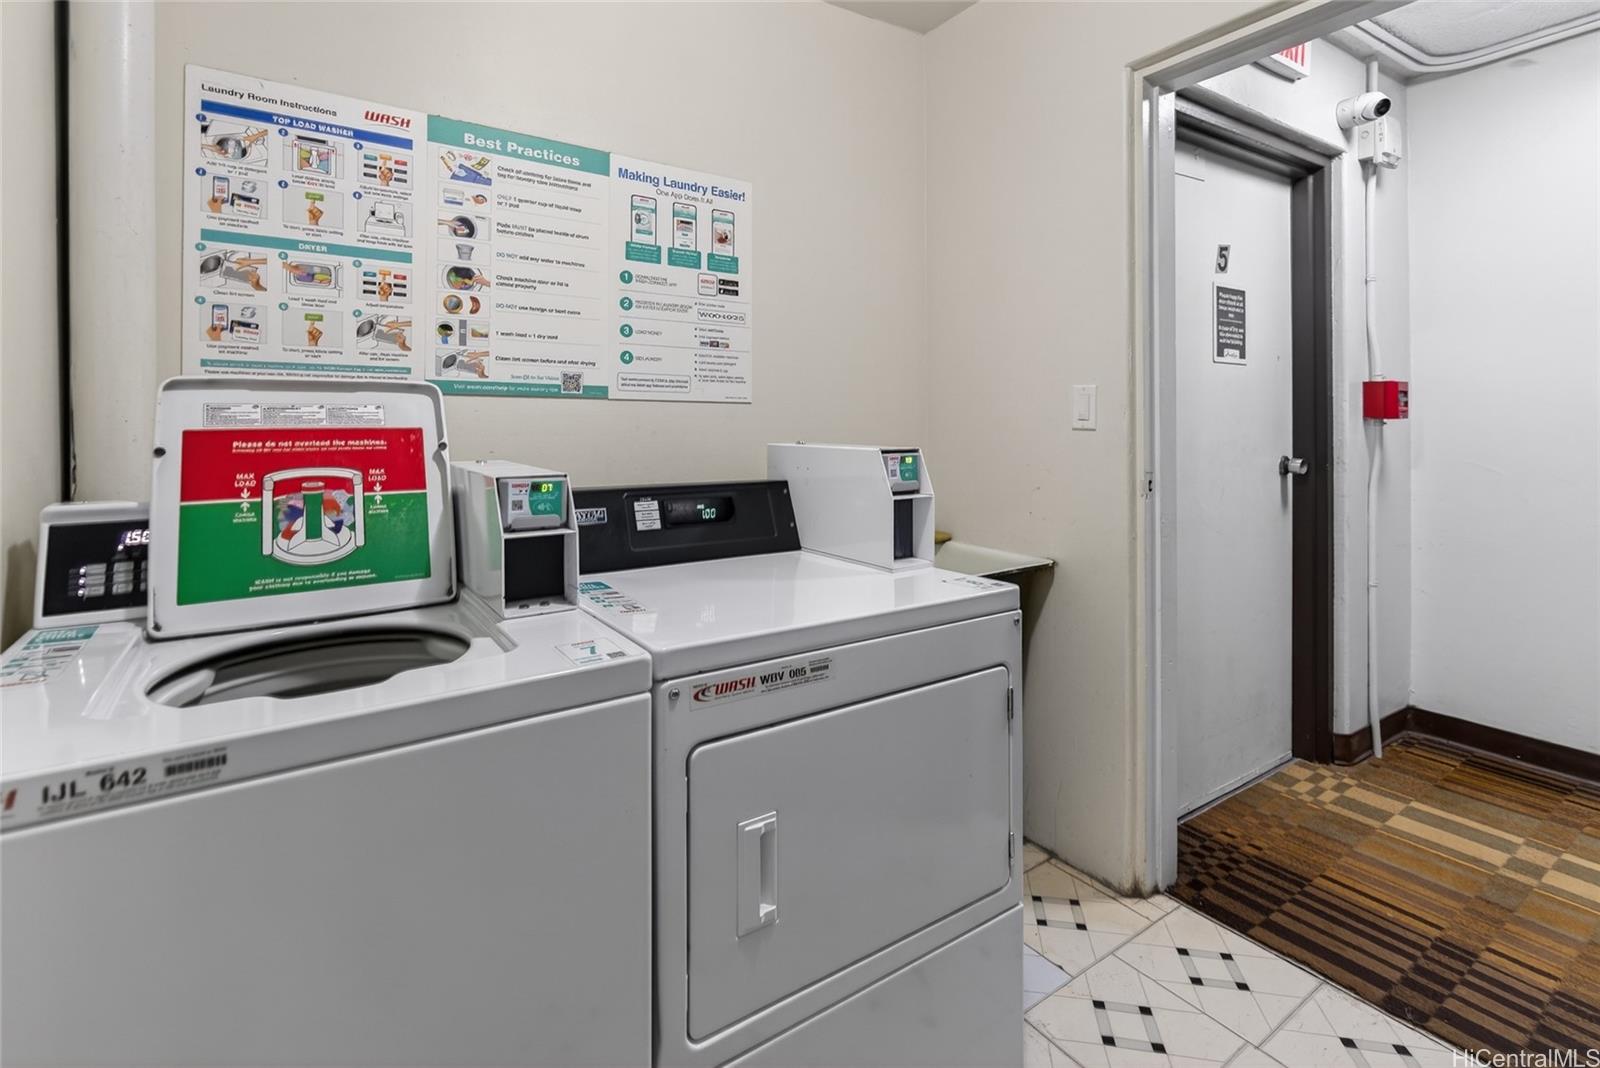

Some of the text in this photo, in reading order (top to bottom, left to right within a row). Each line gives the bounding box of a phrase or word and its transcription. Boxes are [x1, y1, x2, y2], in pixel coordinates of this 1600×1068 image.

[201, 83, 337, 117] Laundry Room Instructions
[273, 115, 354, 137] TOP LOAD WASHER
[365, 110, 410, 129] WASH
[464, 133, 580, 166] Best Practices
[618, 167, 746, 202] Making Laundry Easier!
[656, 188, 669, 196] One
[670, 192, 682, 200] App
[298, 243, 328, 253] DRYER
[1217, 246, 1228, 272] 5
[623, 300, 629, 308] 2
[623, 354, 630, 362] 4
[234, 480, 257, 488] LOAD
[368, 474, 387, 482] LOAD
[541, 483, 553, 493] 07
[714, 677, 756, 695] WASH
[760, 671, 784, 685] WBV
[42, 780, 86, 804] IJL
[99, 767, 147, 791] 642
